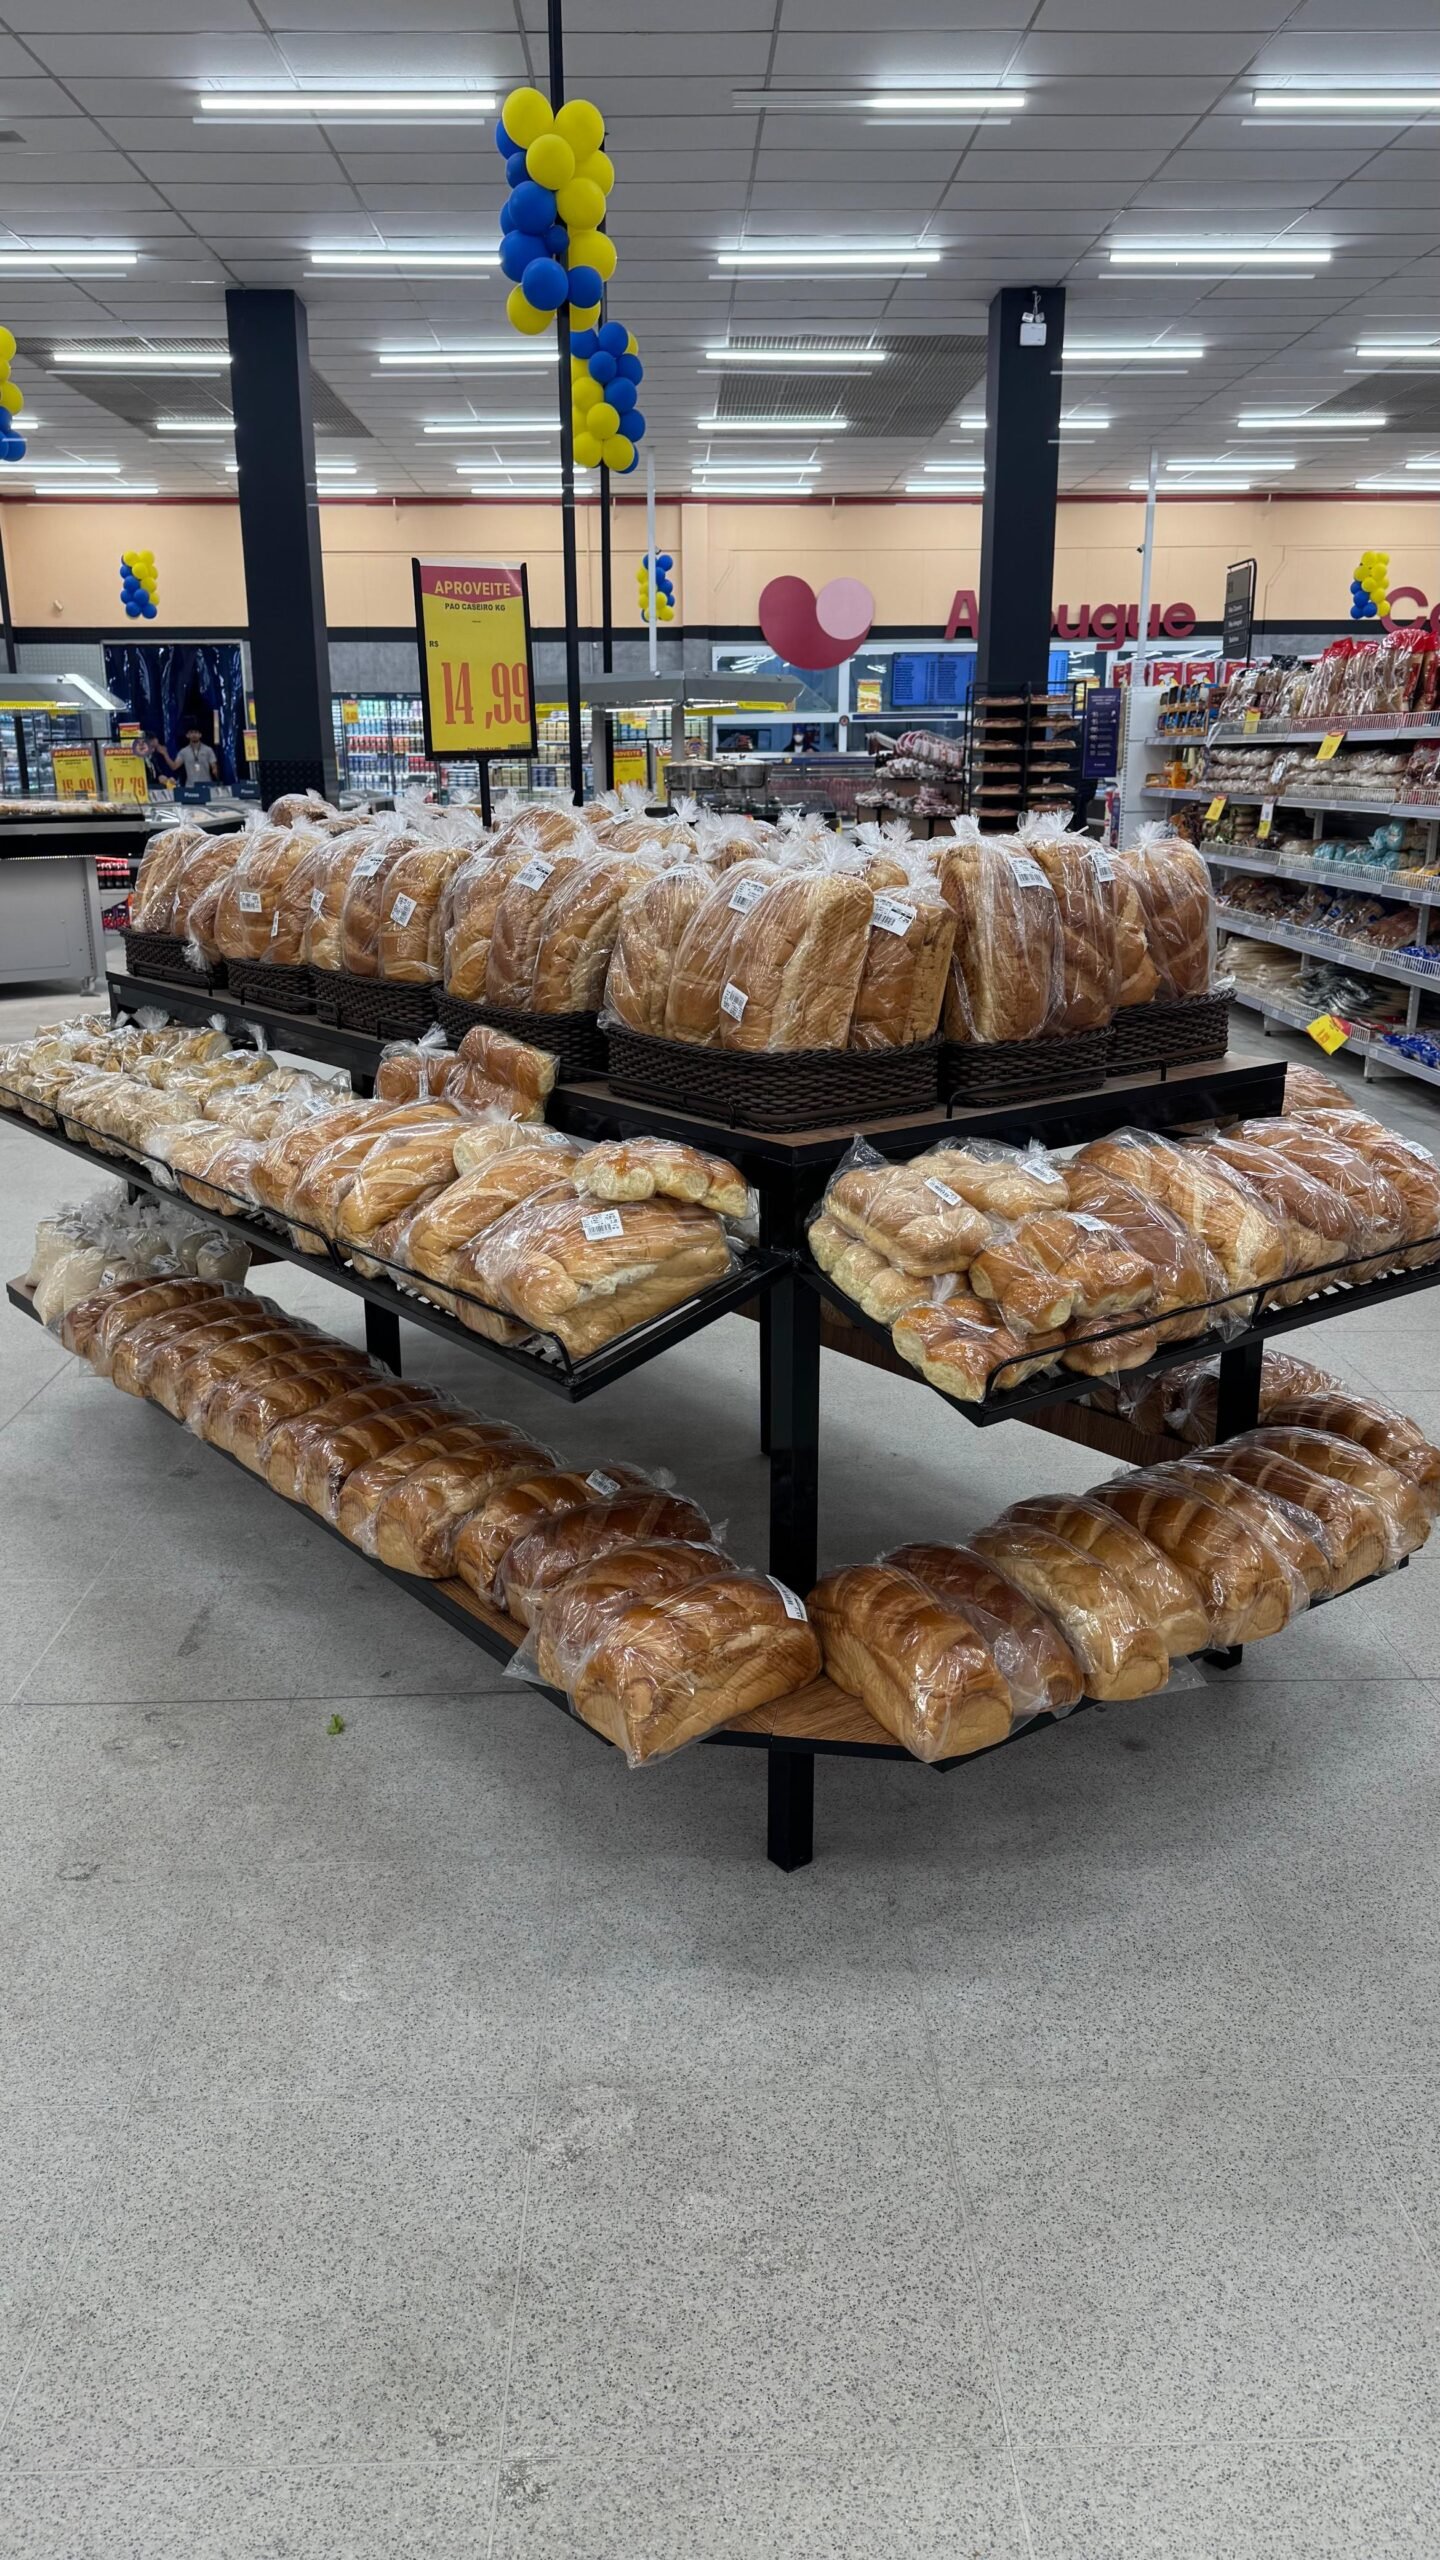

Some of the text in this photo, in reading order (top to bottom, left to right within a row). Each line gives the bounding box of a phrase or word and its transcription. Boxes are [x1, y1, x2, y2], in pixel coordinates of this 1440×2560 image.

[434, 580, 511, 596] APROVEITE
[444, 602, 506, 612] PAO CASEIRO KG
[944, 590, 1196, 650] Augue
[429, 640, 439, 648] R$
